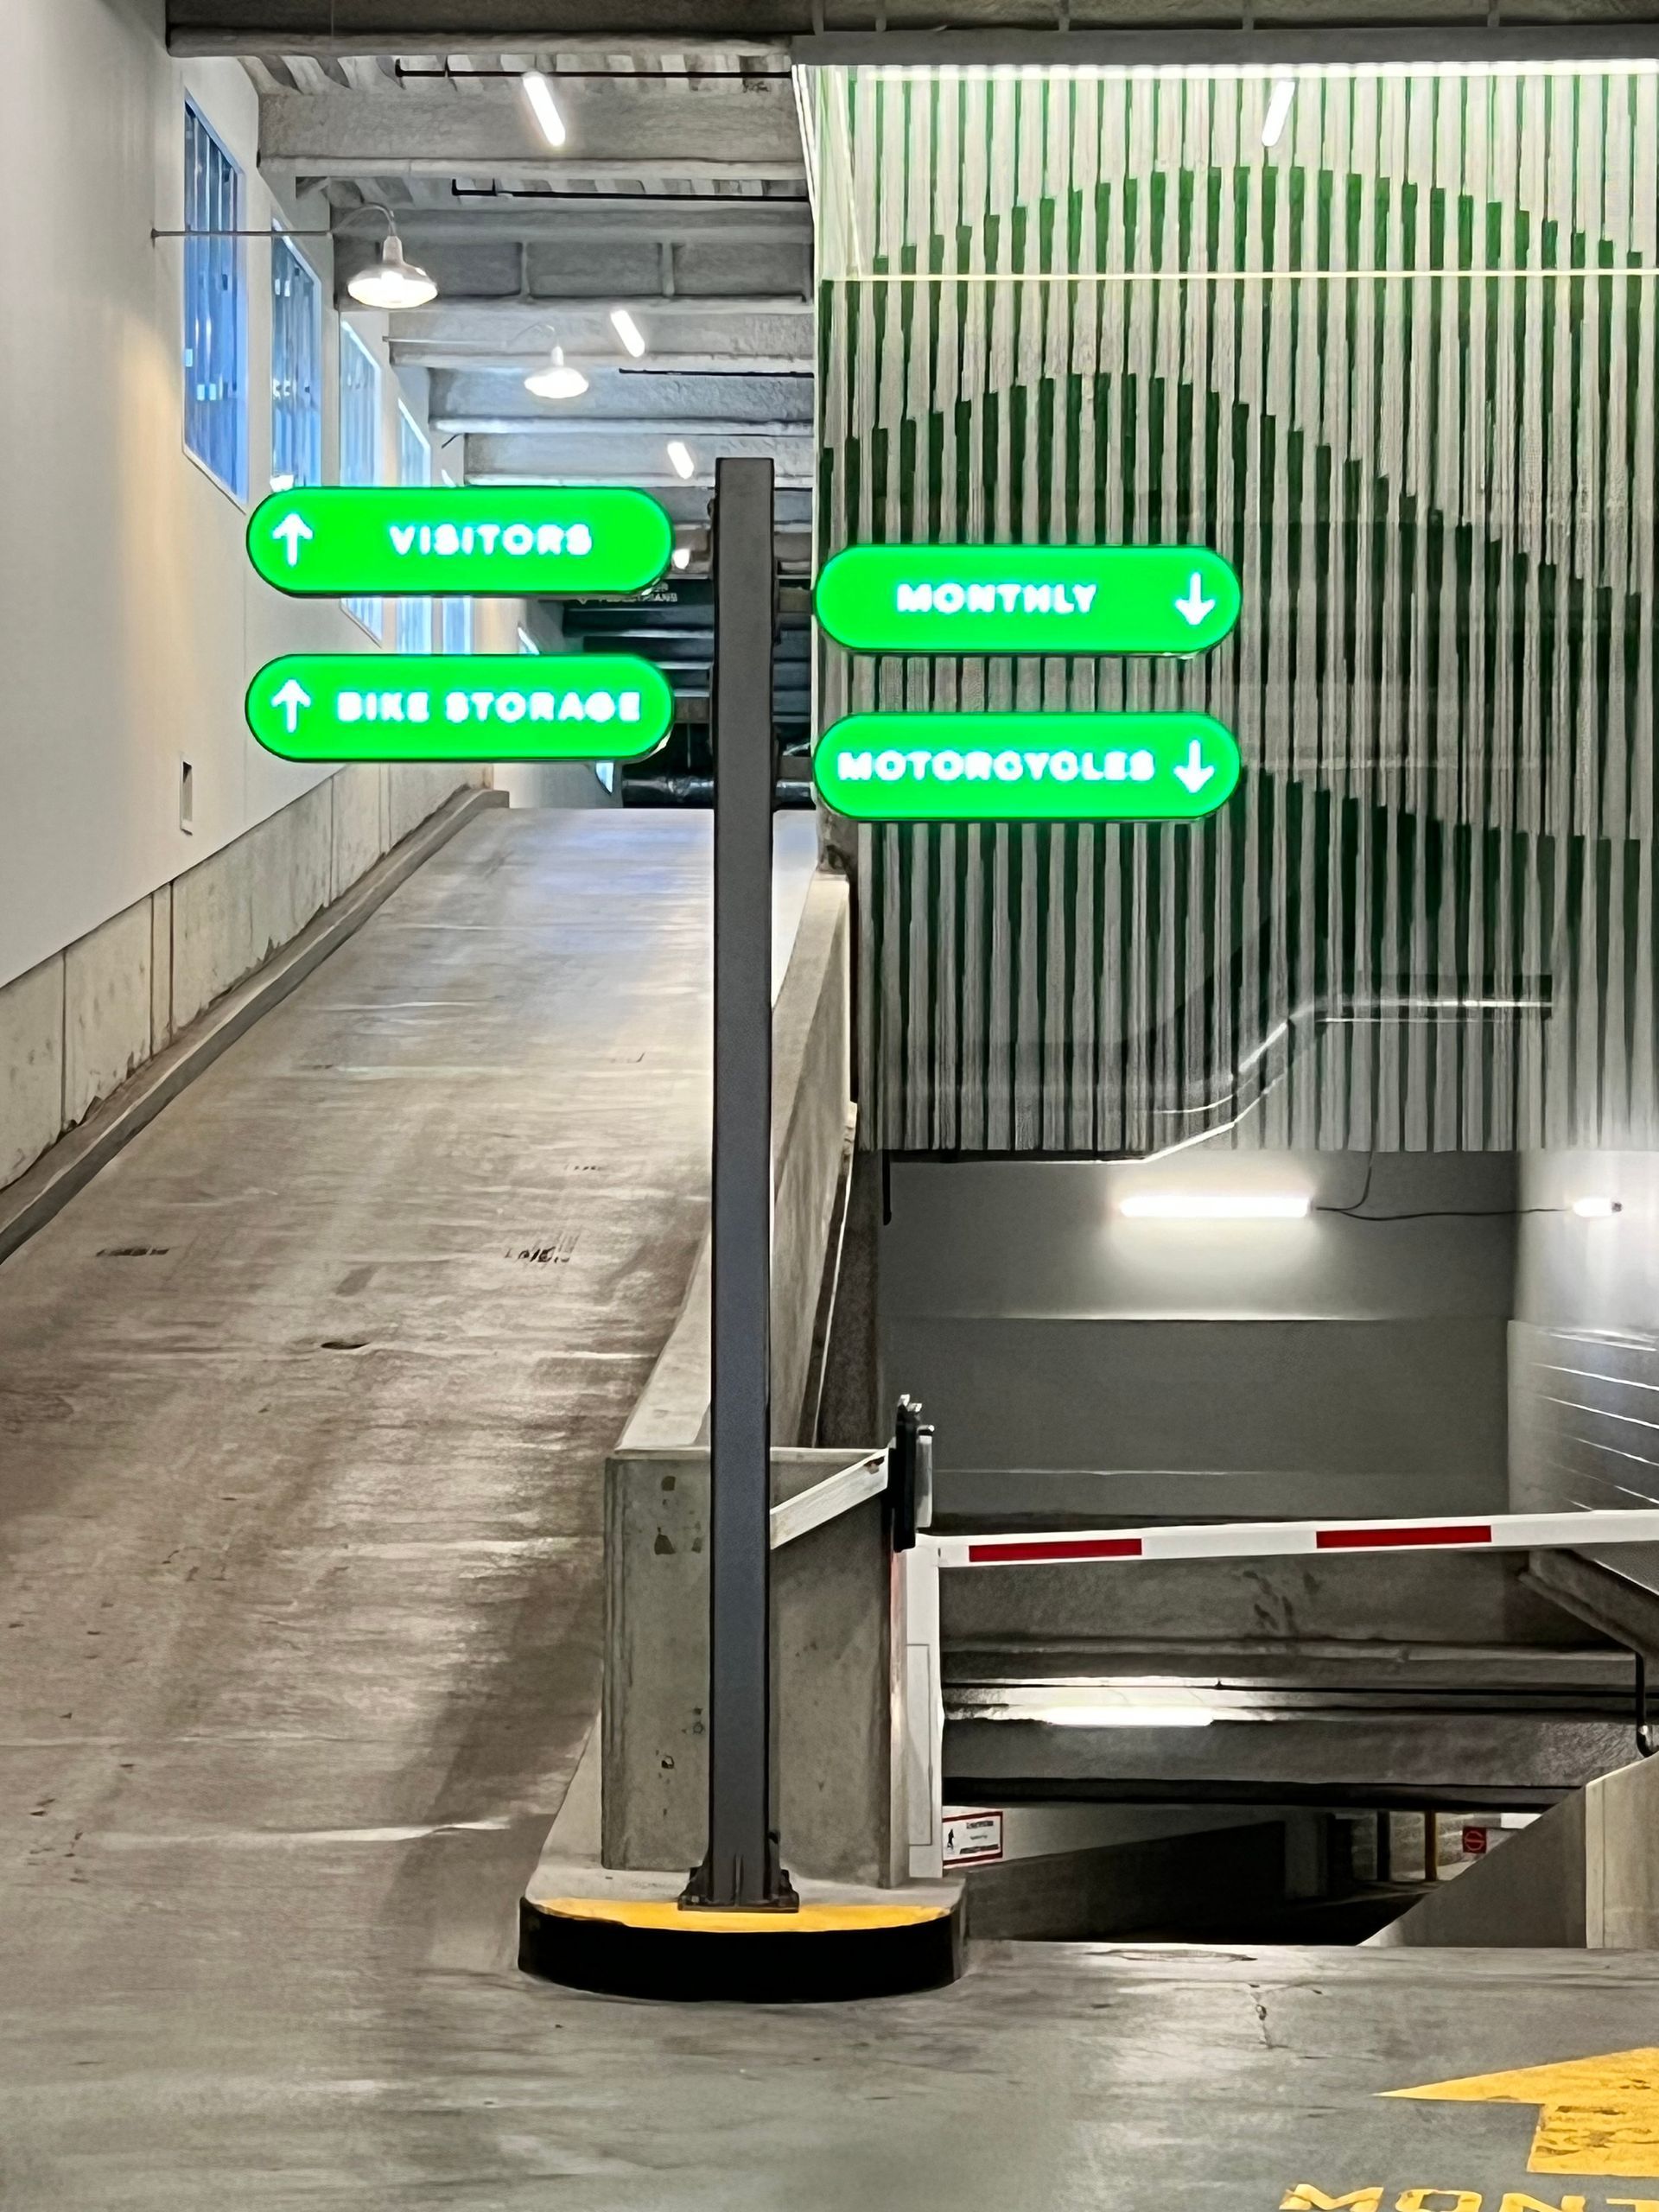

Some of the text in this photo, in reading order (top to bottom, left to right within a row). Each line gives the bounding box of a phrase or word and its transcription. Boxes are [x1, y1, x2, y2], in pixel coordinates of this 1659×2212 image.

[390, 524, 593, 556] VISITORS
[897, 583, 1097, 613] MONTHLY
[337, 691, 642, 722] BIKE STORAGE
[838, 750, 1156, 781] MOTORCYCLES
